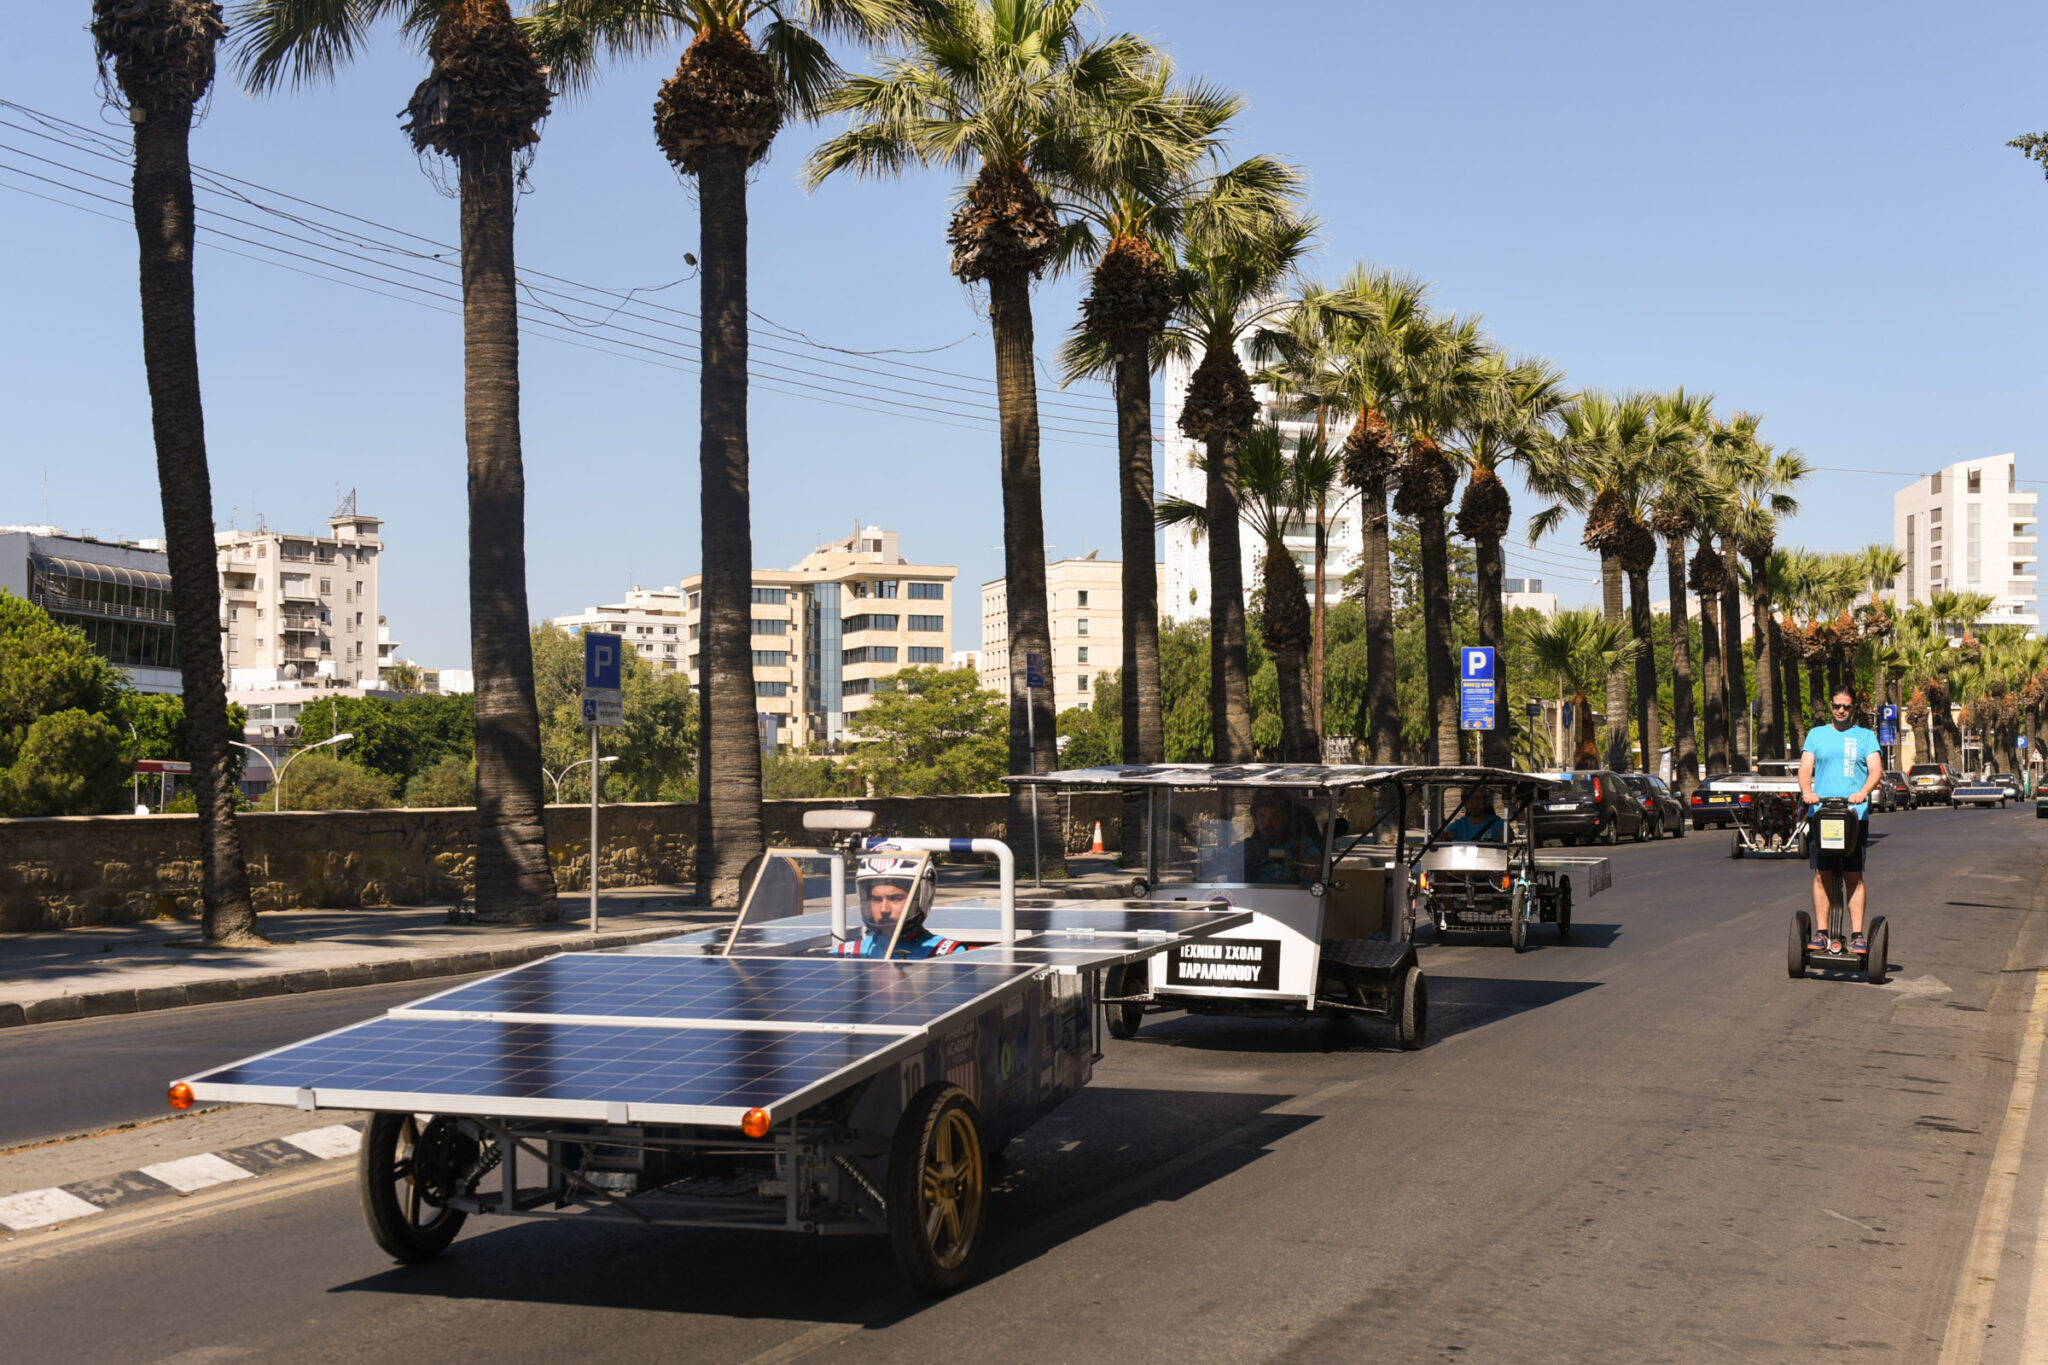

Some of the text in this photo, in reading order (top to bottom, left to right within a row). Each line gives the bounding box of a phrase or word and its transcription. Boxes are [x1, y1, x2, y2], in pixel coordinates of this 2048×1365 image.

[595, 645, 612, 677] P
[1469, 651, 1487, 676] P
[1883, 708, 1893, 720] P
[2018, 738, 2025, 746] P
[1225, 946, 1262, 961] ΣΧΟΛΗ
[1179, 962, 1261, 981] ΠΑΡΑΛΙΜΝΙΟΥ
